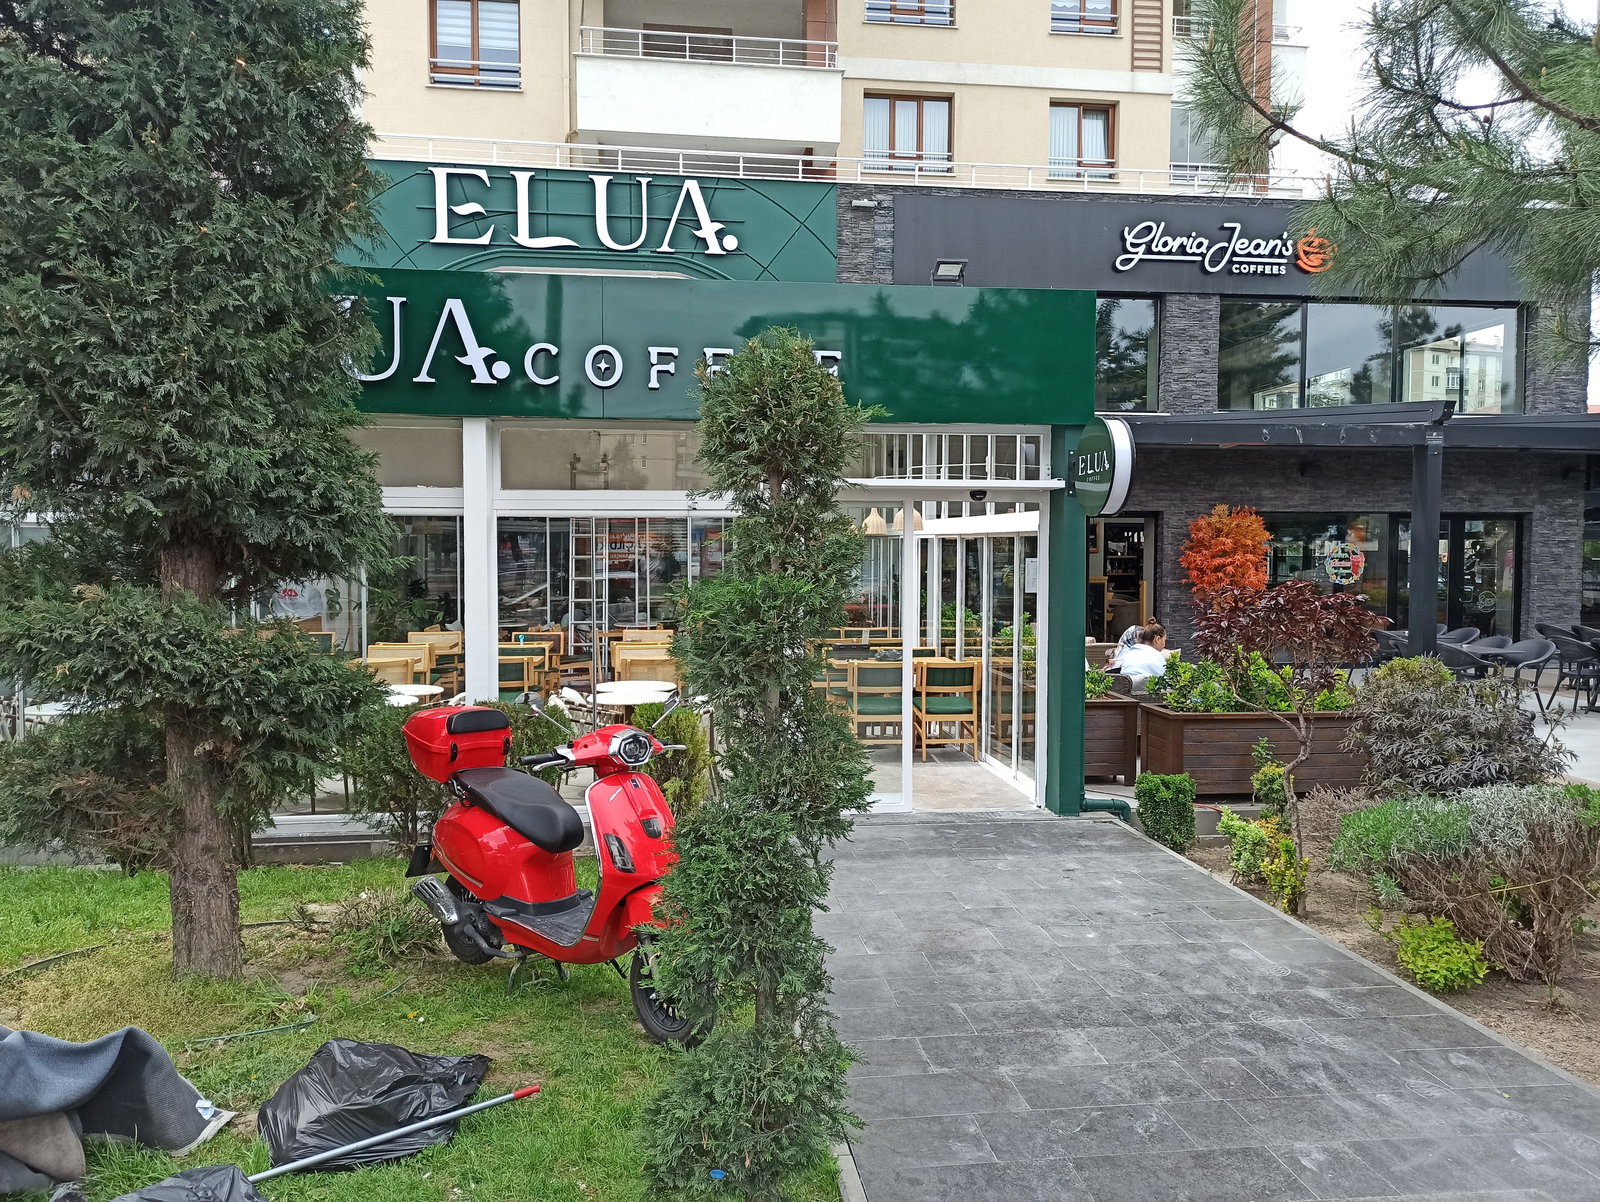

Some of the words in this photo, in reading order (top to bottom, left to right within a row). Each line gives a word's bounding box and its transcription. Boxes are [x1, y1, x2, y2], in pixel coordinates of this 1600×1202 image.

[1115, 221, 1207, 271] Gloria
[1204, 222, 1293, 272] Jean's
[1232, 264, 1287, 275] COFFEES
